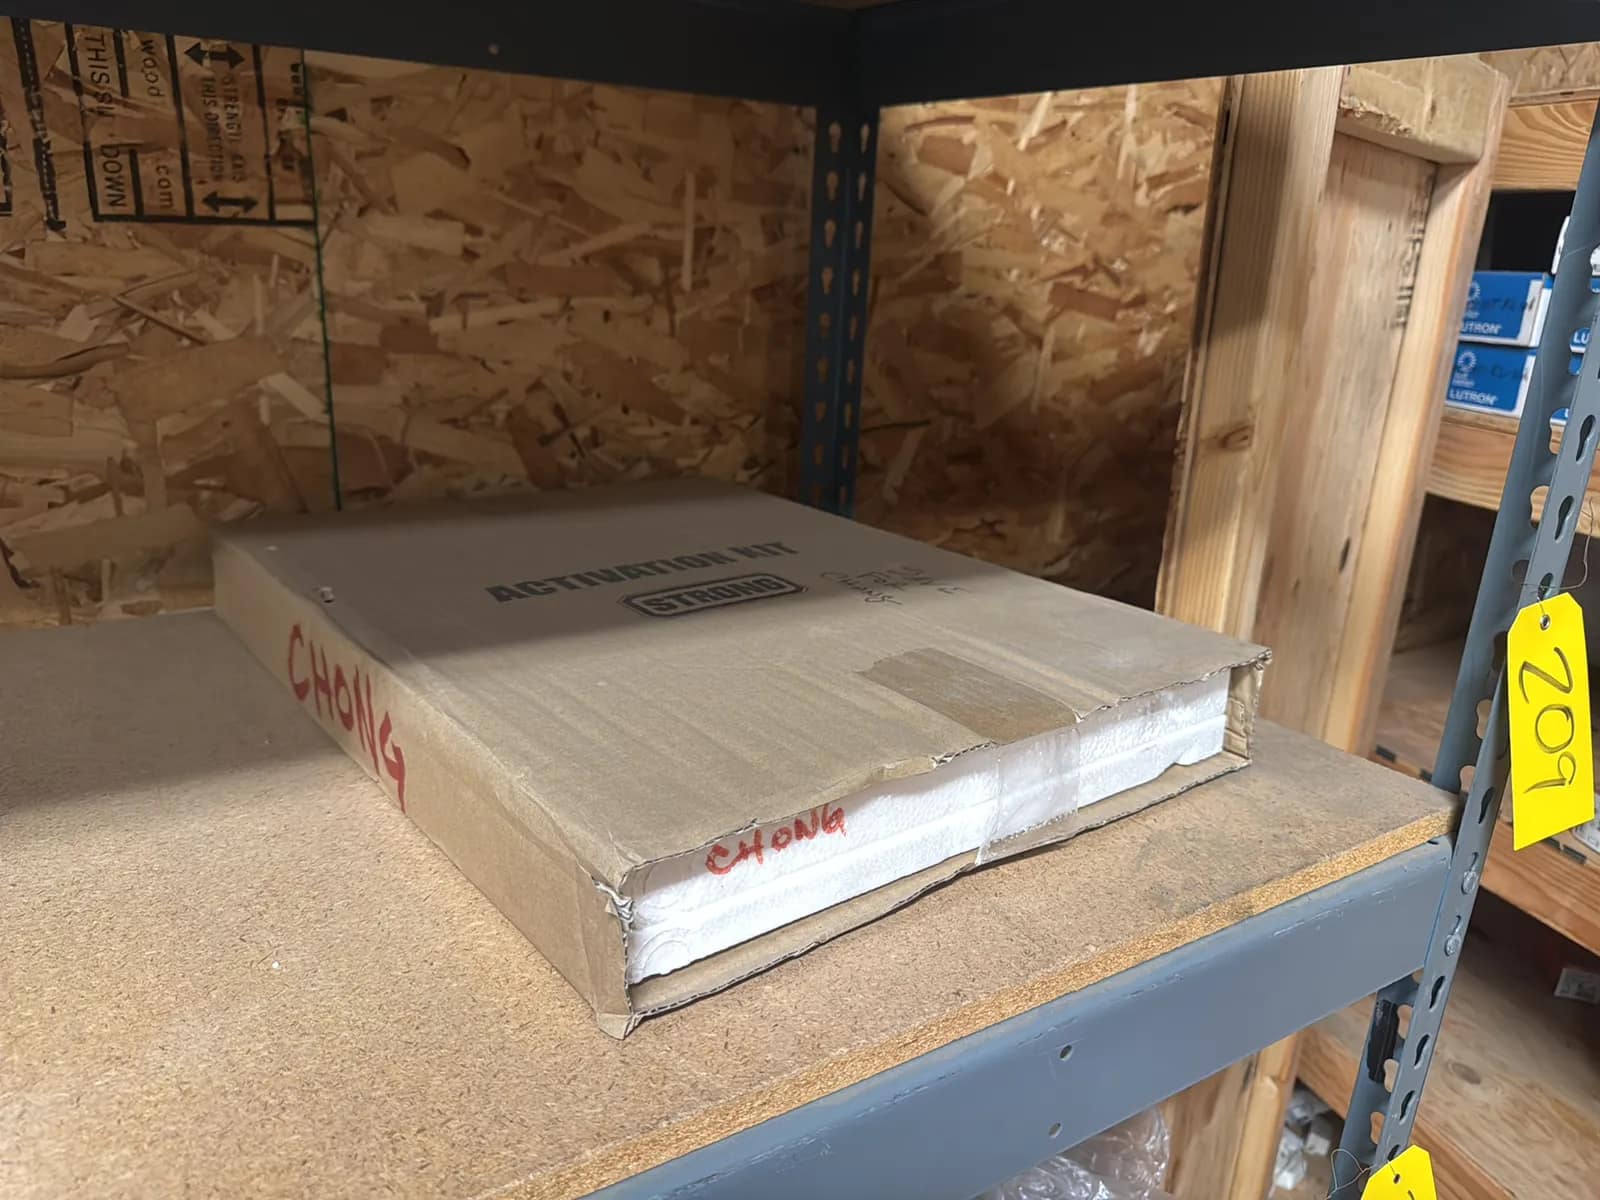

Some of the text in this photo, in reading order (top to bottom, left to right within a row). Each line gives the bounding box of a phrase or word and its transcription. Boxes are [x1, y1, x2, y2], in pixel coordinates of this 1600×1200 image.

[84, 33, 110, 94] THIS
[102, 145, 126, 208] DOWN
[1459, 321, 1501, 335] UTRON
[1449, 389, 1498, 406] LUTRON
[484, 542, 799, 602] ACTIVATION KIT
[642, 578, 787, 612] STRONG
[288, 623, 406, 814] CHONG
[705, 803, 847, 875] CHONG
